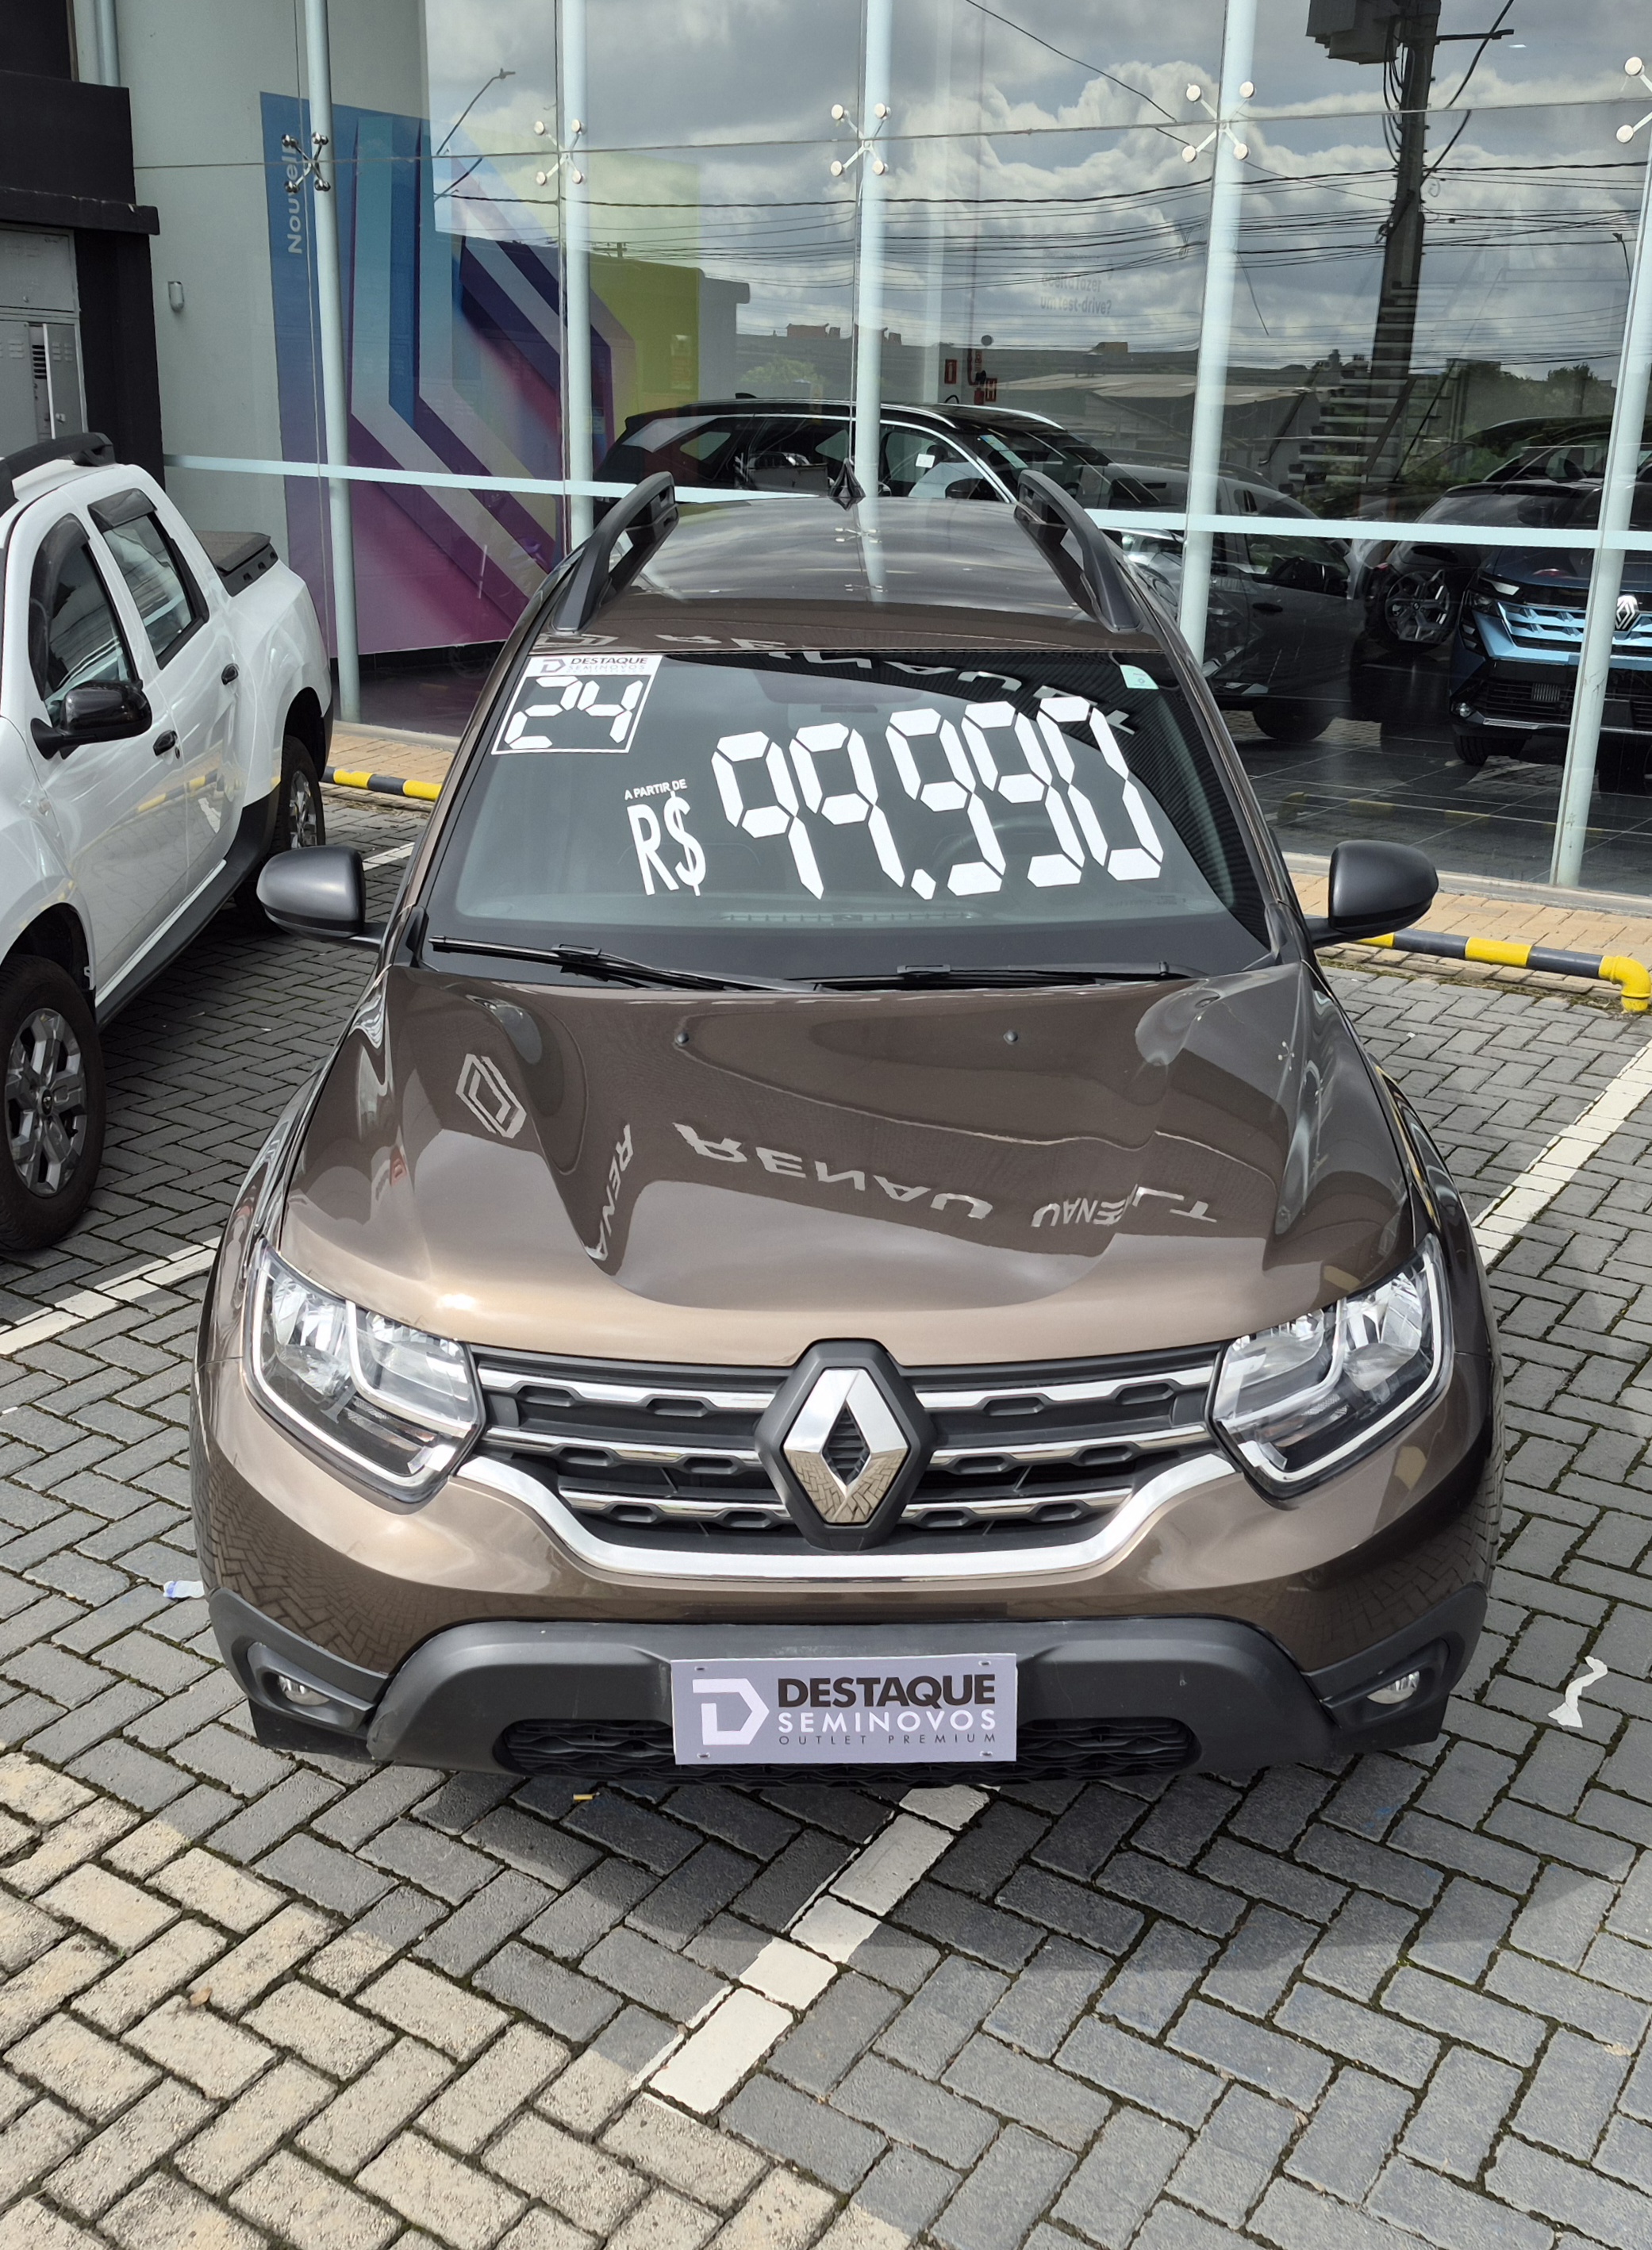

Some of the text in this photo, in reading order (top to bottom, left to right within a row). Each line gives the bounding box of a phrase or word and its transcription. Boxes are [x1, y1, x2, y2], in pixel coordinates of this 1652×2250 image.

[504, 676, 644, 750] 24
[624, 778, 688, 801] A PARTIR DE
[712, 696, 1164, 900] 99.990
[626, 790, 706, 897] R$
[778, 1674, 996, 1709] DESTAQUE
[778, 1709, 996, 1734] SEMINOVOS
[779, 1734, 996, 1745] OUTLET PREMIUM
